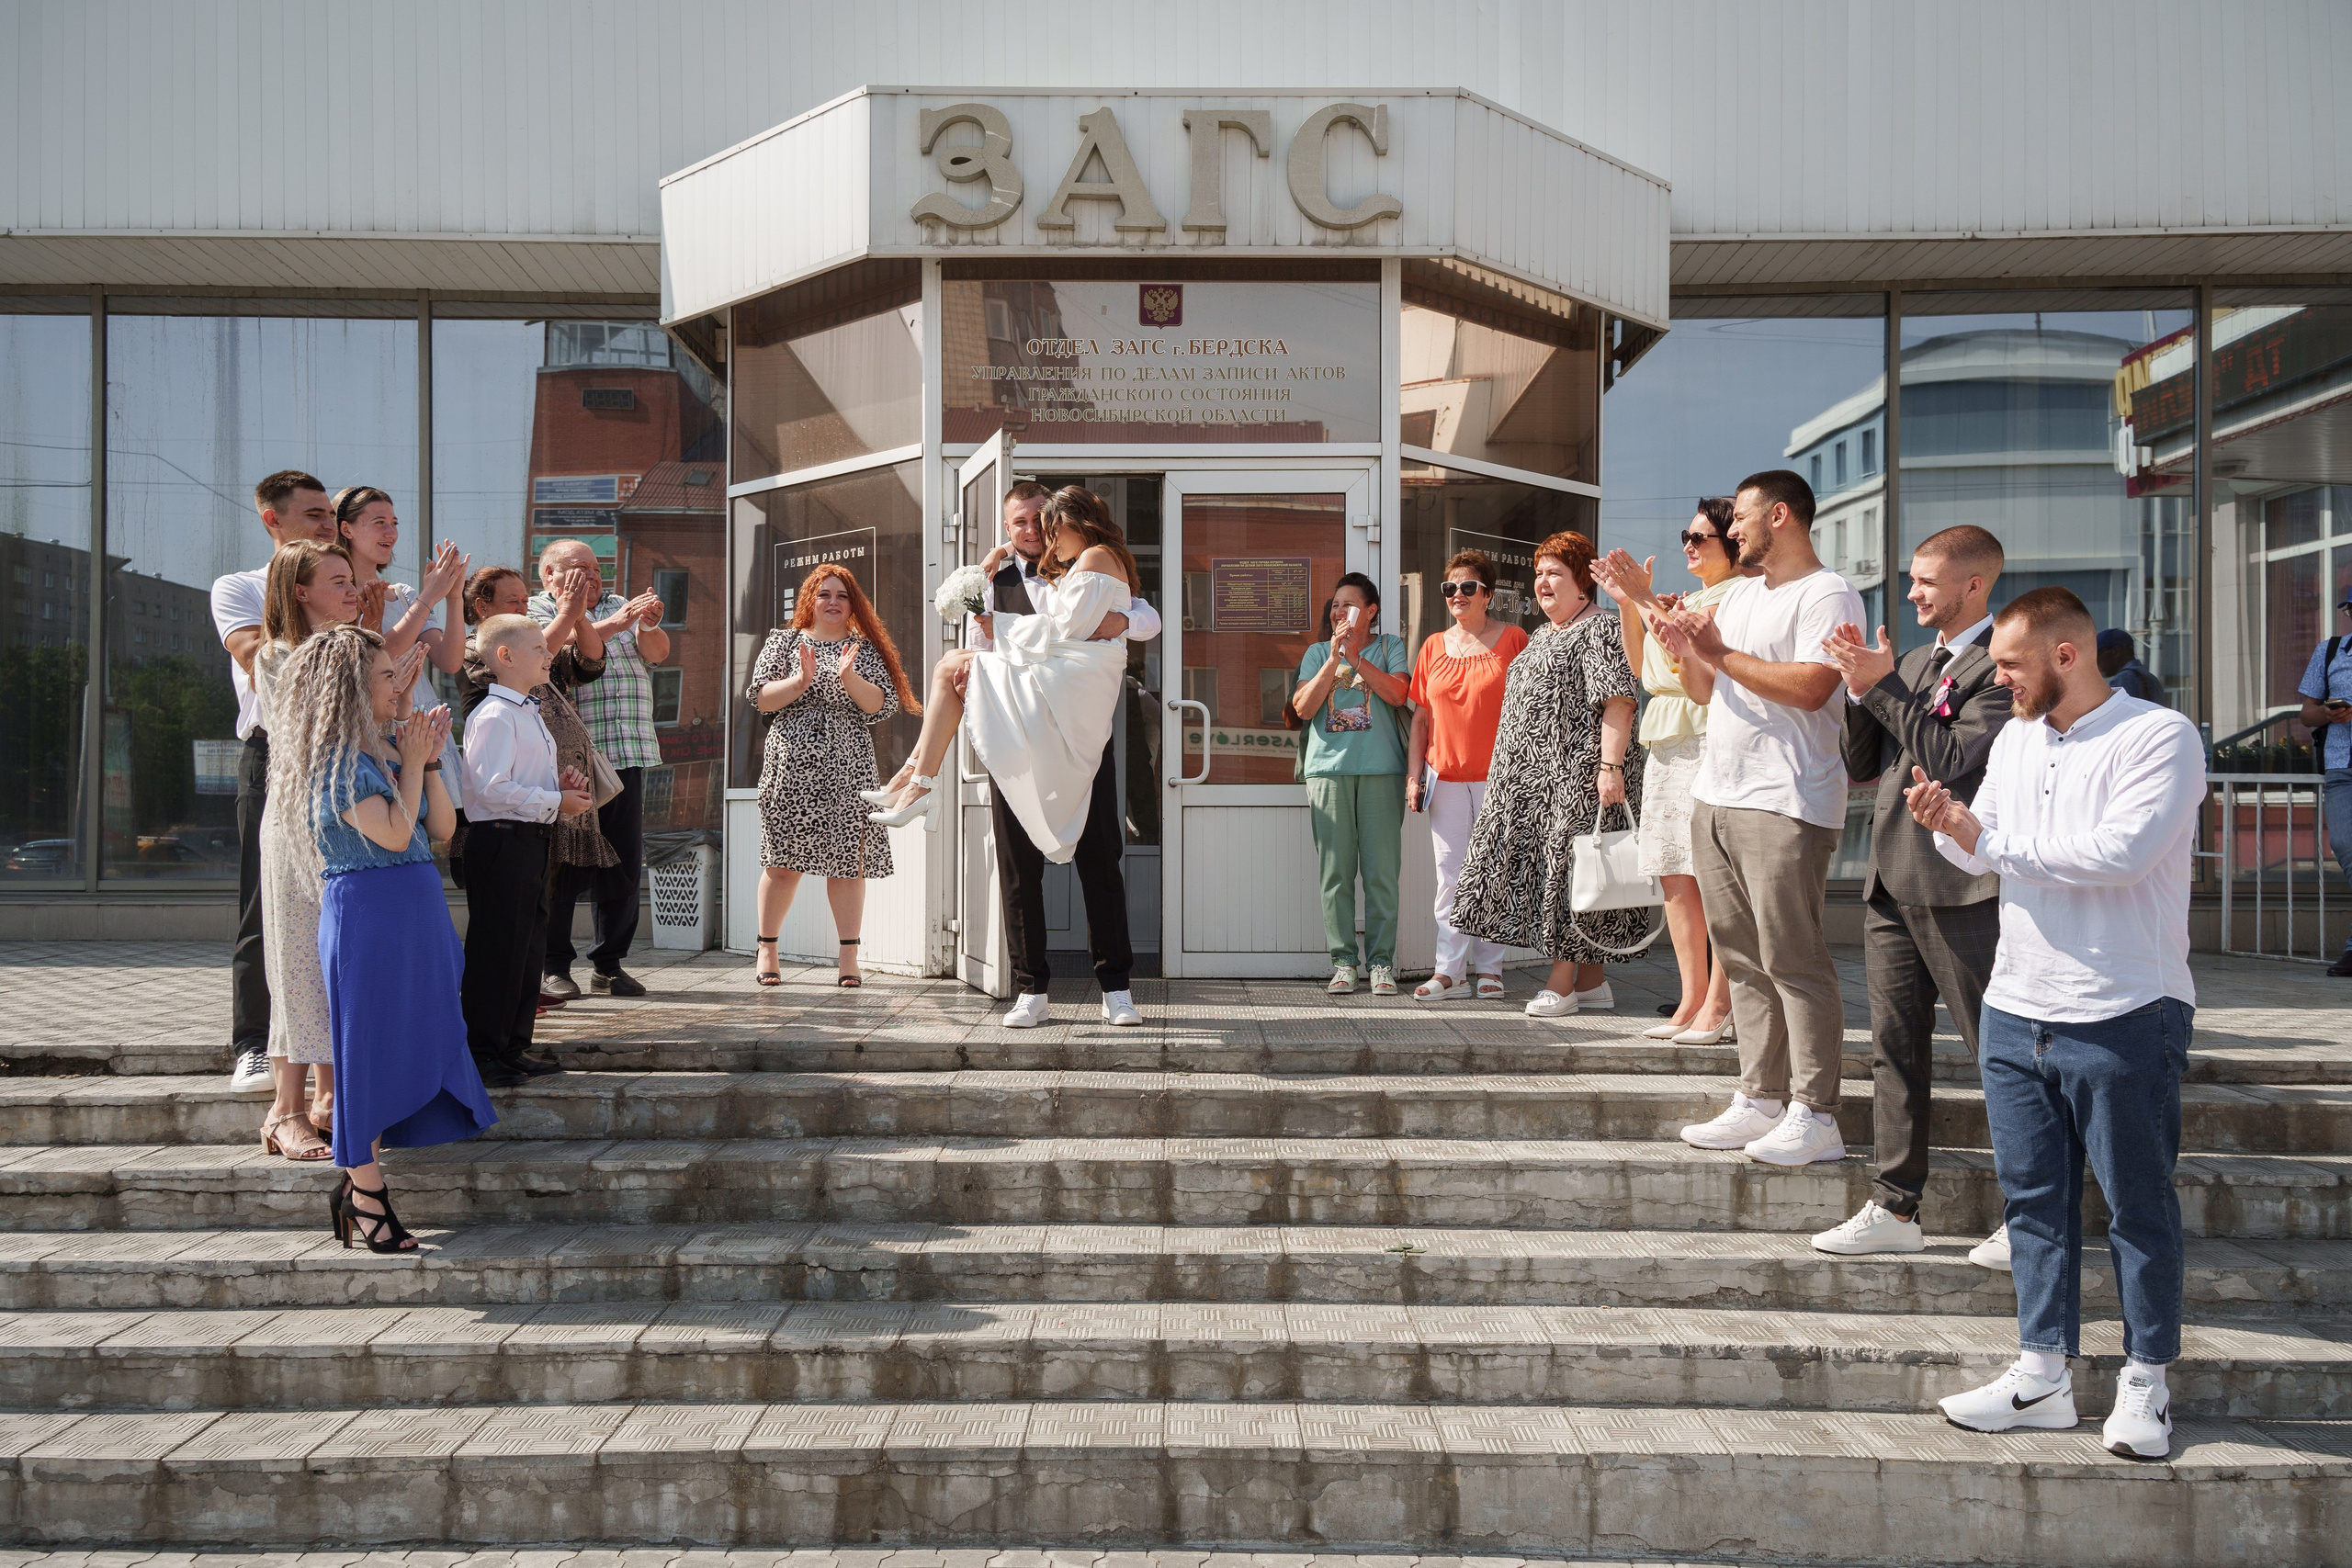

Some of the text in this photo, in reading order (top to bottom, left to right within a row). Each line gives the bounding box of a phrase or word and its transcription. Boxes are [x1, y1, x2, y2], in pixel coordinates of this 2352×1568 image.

[910, 103, 1403, 233] ЗАГС
[1026, 338, 1101, 358] ОТДЕЛ
[1109, 338, 1166, 356] ЗАГС
[971, 366, 1346, 382] УПРАВЛЕНИЯ ПО ДЕЛАМ ЗАПИСИ АКТОВ
[1028, 387, 1292, 402] ГРАЖДАНСКОГО СОСТОЯНИЯ
[1030, 404, 1287, 423] НОВОСИБИРСКОЙ ОБЛАСТИ
[784, 547, 865, 569] РЕЖИМ РАБОТЫ
[1501, 553, 1533, 568] РАБОТ
[2132, 1375, 2147, 1384] NIKE
